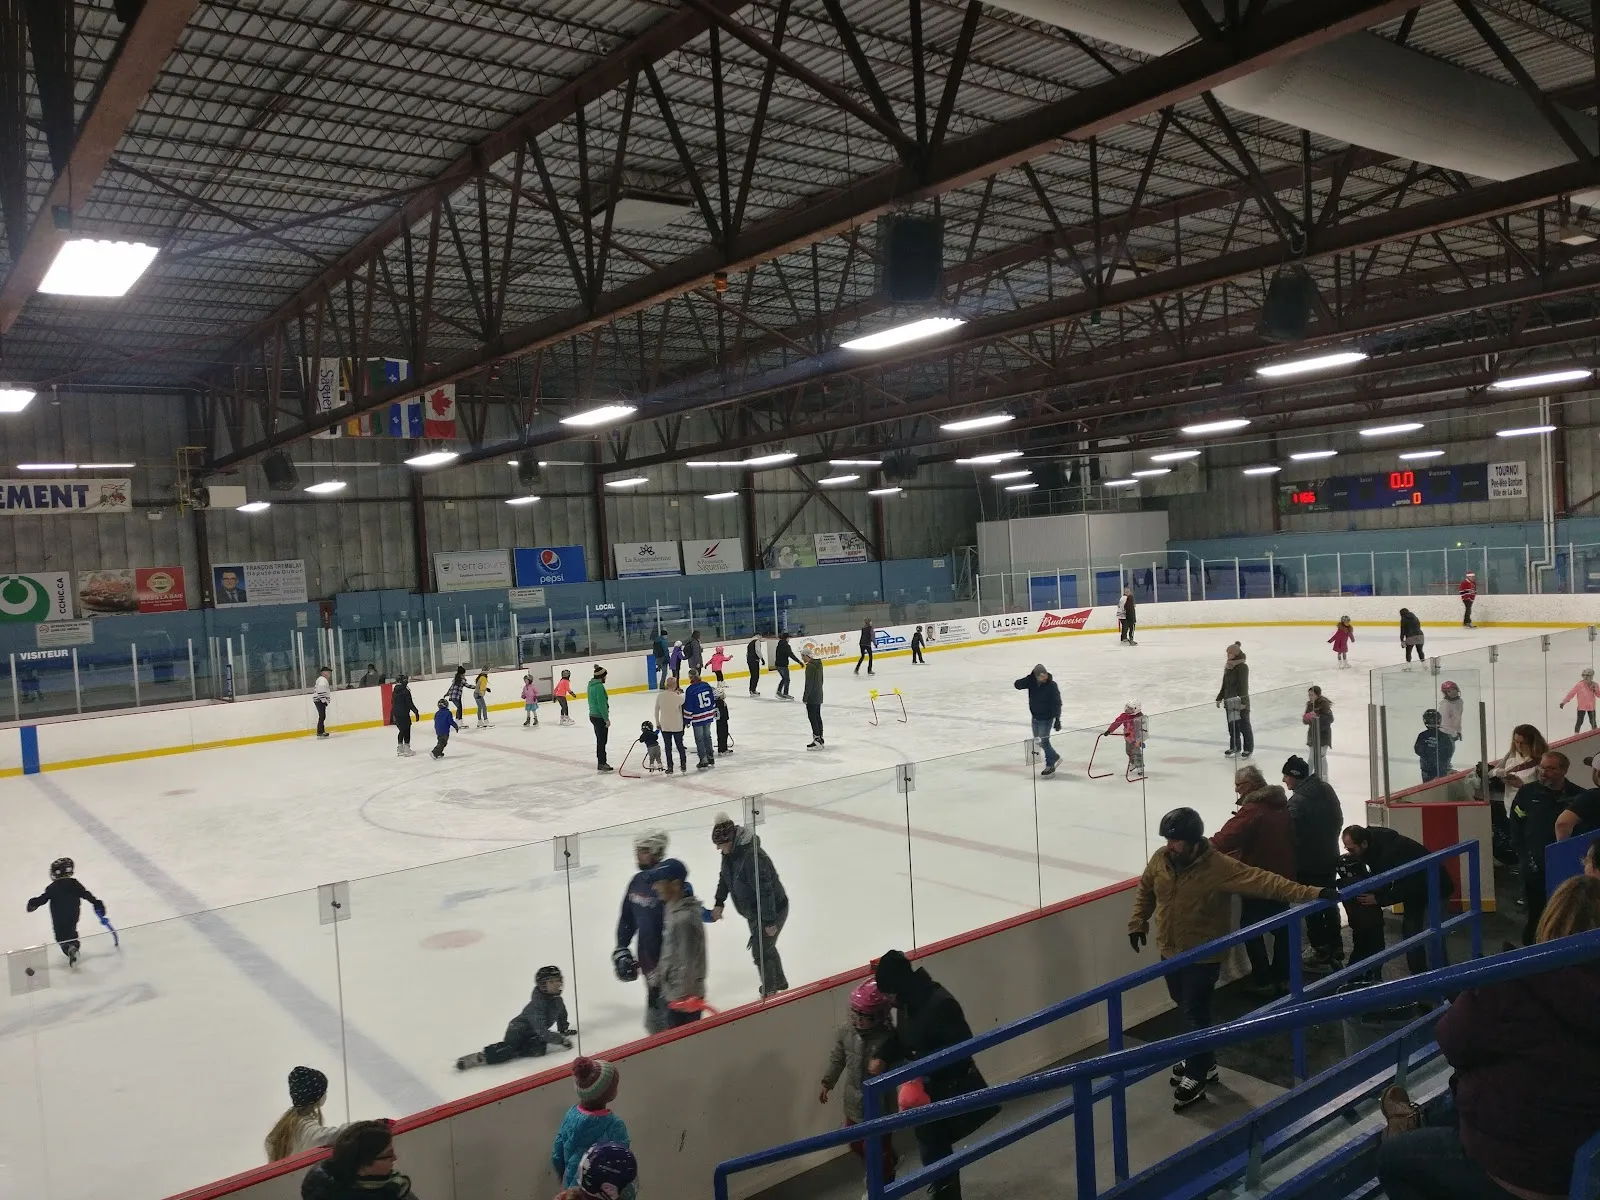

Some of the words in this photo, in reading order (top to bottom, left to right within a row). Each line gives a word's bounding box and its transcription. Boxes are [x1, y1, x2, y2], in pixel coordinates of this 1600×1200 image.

[1496, 465, 1519, 476] TOURNOI
[1508, 488, 1513, 496] La
[540, 574, 564, 584] pepsi
[57, 577, 67, 614] CCHIC.CA
[595, 603, 616, 611] LOCAL
[992, 619, 1004, 628] LA
[1005, 616, 1028, 627] CAGE
[1042, 615, 1088, 627] Budweiser
[20, 649, 69, 660] VISITEUR
[698, 691, 711, 708] 15
